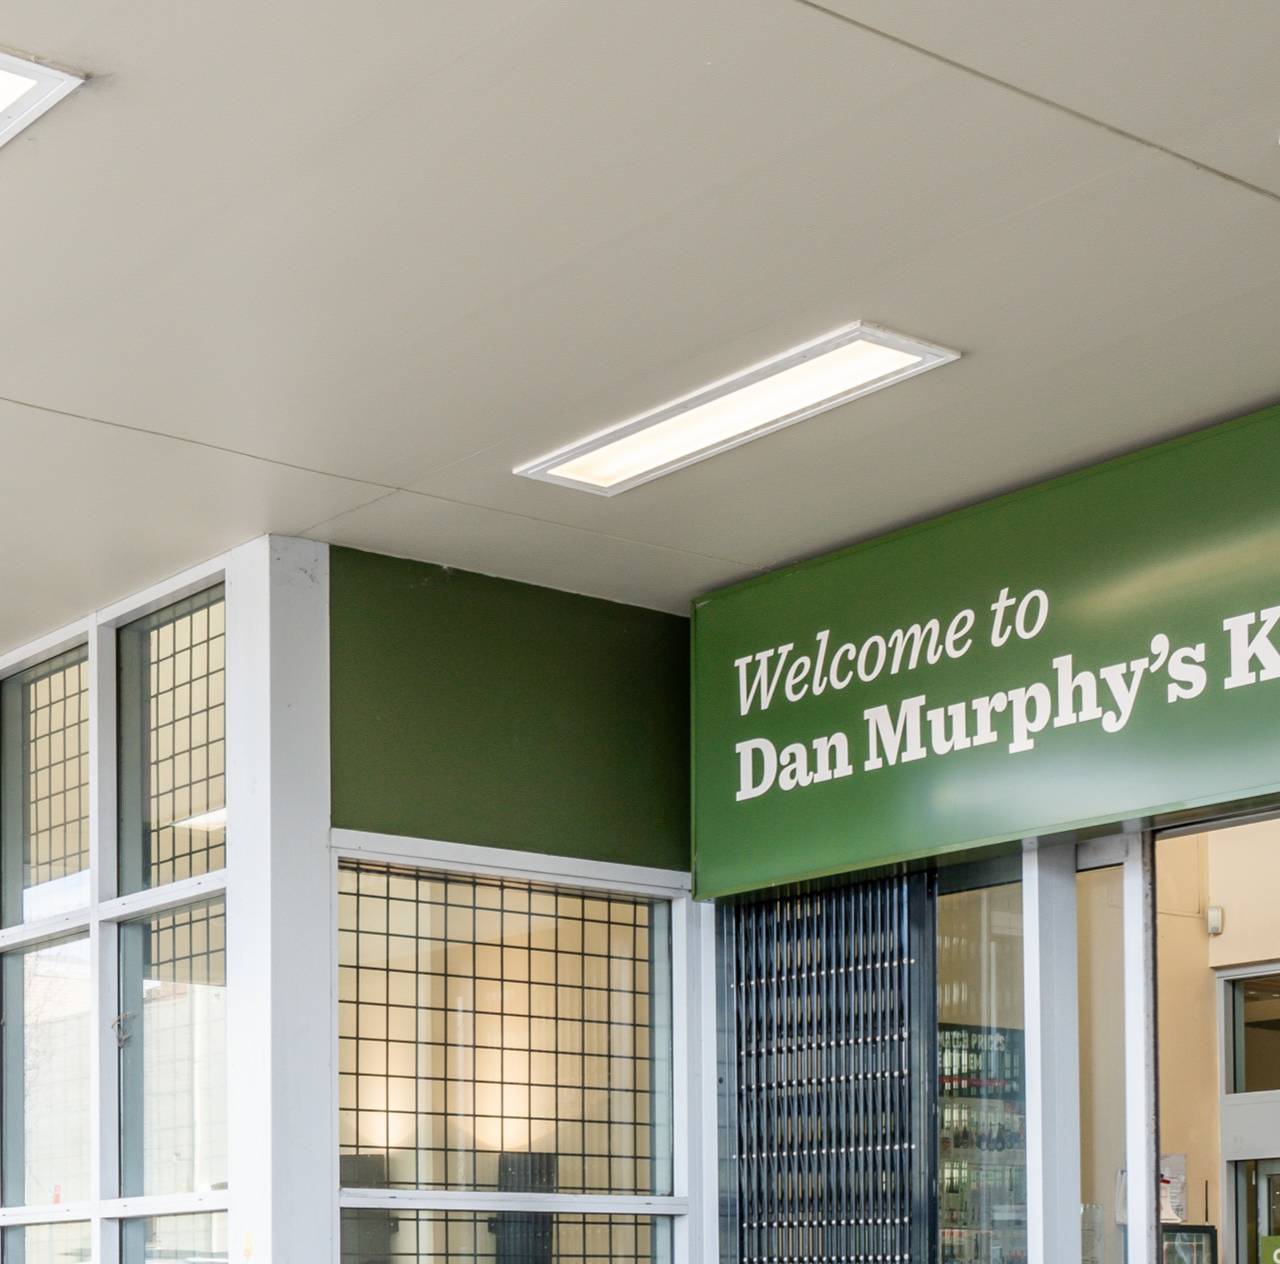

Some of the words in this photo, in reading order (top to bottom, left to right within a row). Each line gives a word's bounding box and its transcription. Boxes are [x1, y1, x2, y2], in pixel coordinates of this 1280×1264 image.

[735, 609, 975, 715] Welcome
[991, 587, 1049, 647] to
[735, 732, 853, 802] Dan
[863, 633, 1207, 772] Murphy's
